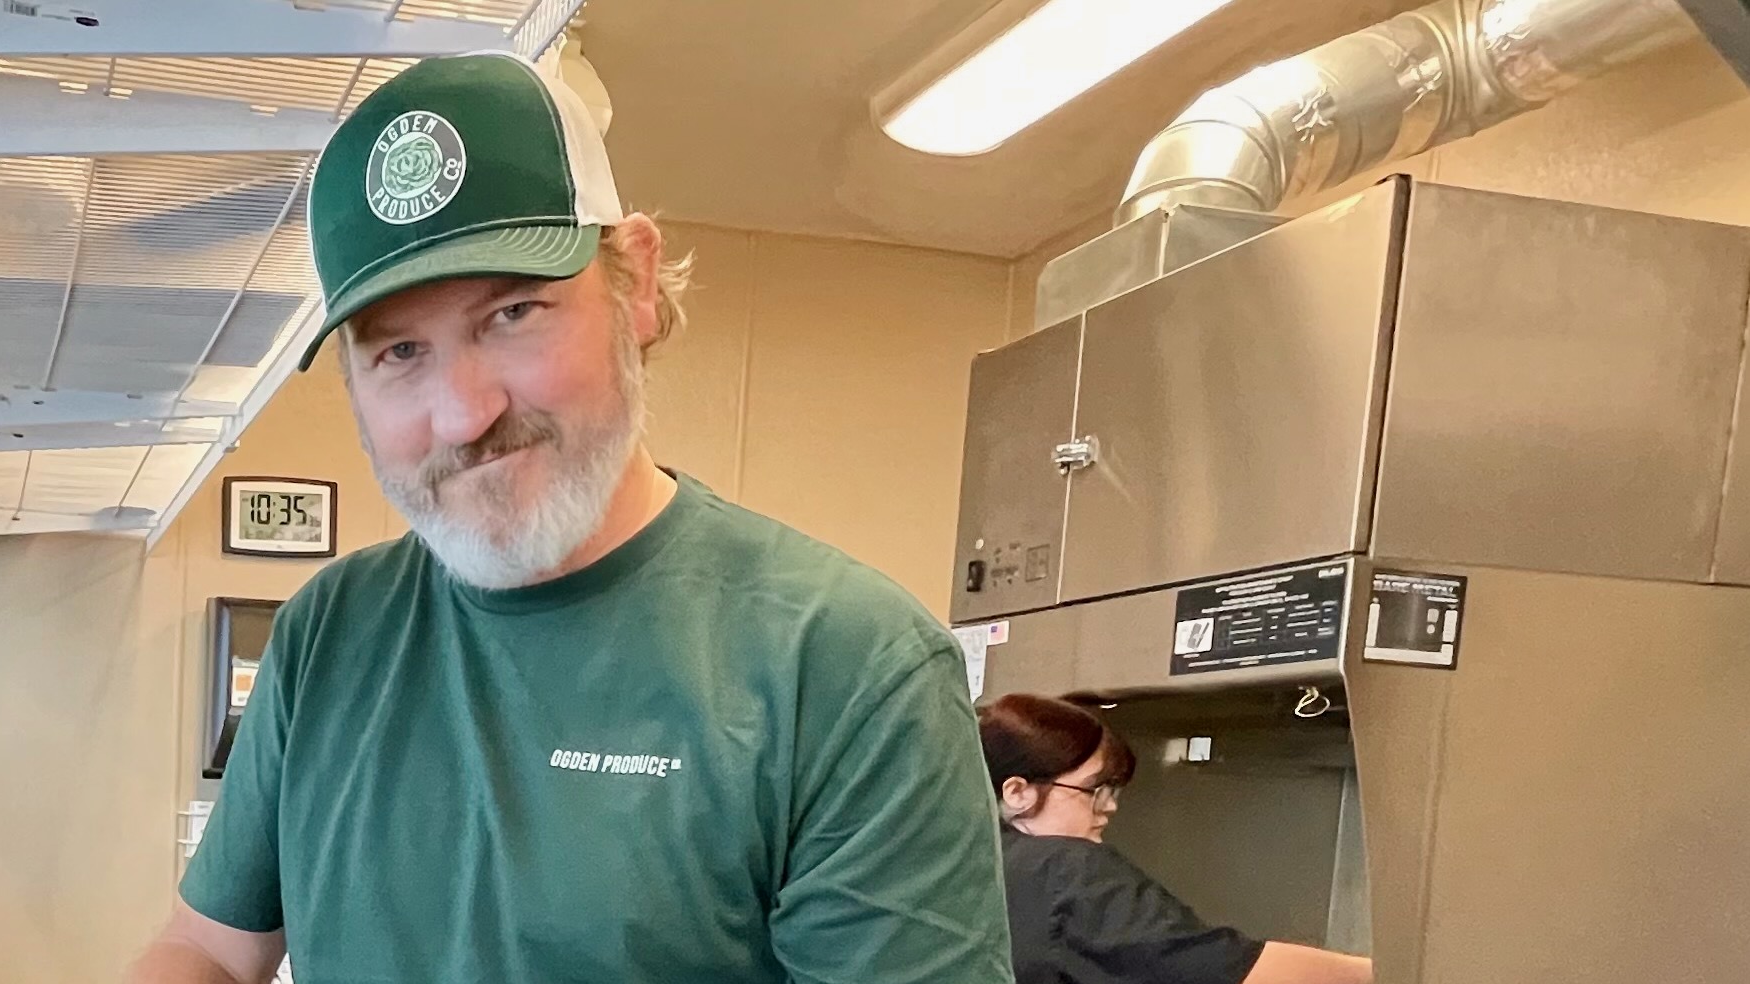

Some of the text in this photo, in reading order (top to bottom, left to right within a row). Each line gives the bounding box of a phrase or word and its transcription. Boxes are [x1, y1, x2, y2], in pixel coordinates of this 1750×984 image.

[377, 114, 439, 153] OGDEN
[371, 185, 447, 219] PRODUCE
[250, 494, 307, 526] 10:35
[549, 748, 600, 773] OGDEN
[600, 754, 670, 778] PRODUCE
